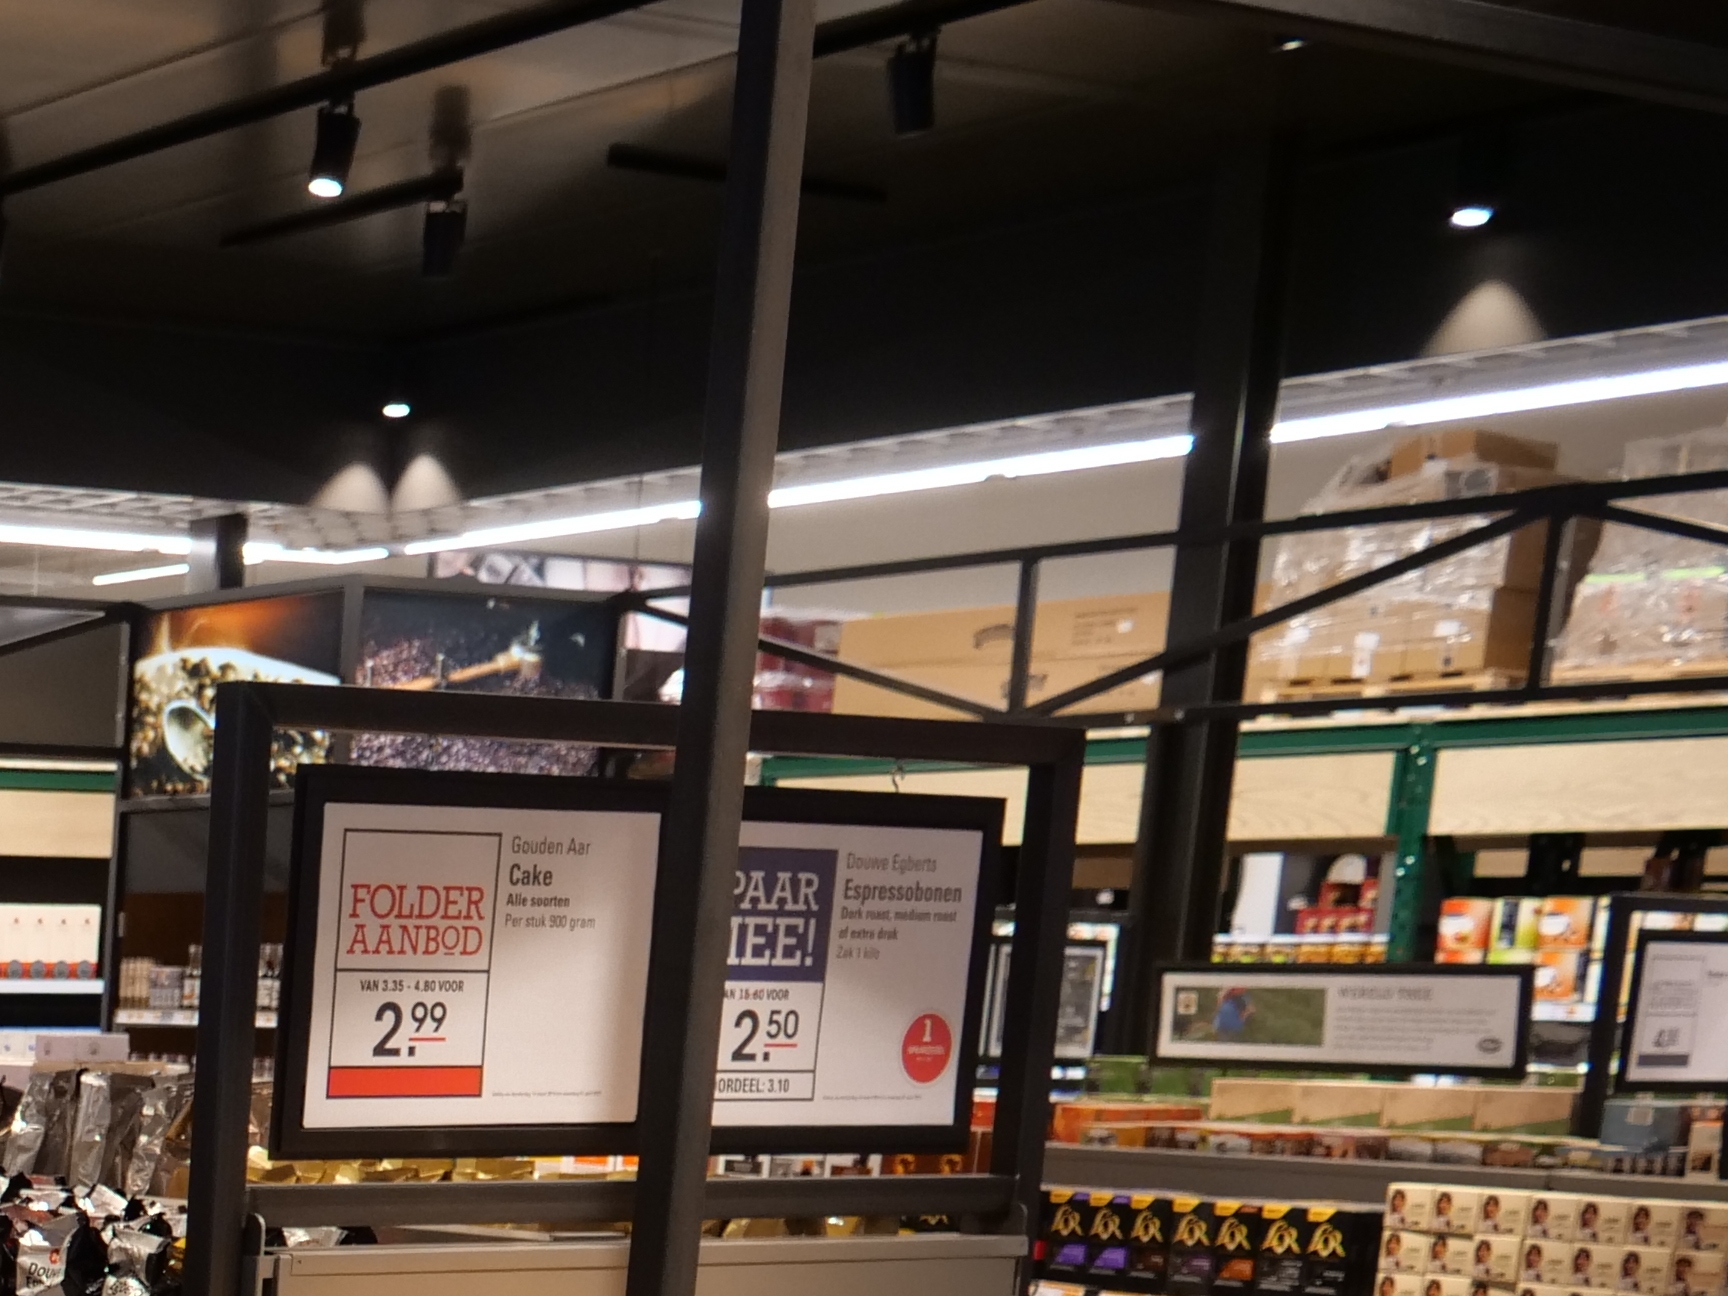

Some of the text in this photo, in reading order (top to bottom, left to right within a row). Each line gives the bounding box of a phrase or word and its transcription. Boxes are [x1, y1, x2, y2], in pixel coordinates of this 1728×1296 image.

[512, 835, 591, 855] Gouden Aar
[509, 863, 553, 886] Cake
[846, 851, 937, 875] Douwe Egberts
[349, 883, 485, 920] FOLDER
[506, 893, 570, 907] Alle soorten
[733, 870, 819, 911] PAAR
[844, 878, 962, 905] Espressobonen
[505, 912, 596, 932] Per stuk 900 gram
[346, 924, 483, 956] AANBOD
[360, 979, 379, 992] VAN
[382, 980, 404, 992] 3.35
[414, 980, 436, 992] 4.80
[438, 980, 464, 992] VOOR
[766, 988, 790, 1000] VOOR
[372, 1001, 448, 1057] 2.99
[922, 1018, 932, 1043] 1
[767, 1078, 790, 1093] 3.10
